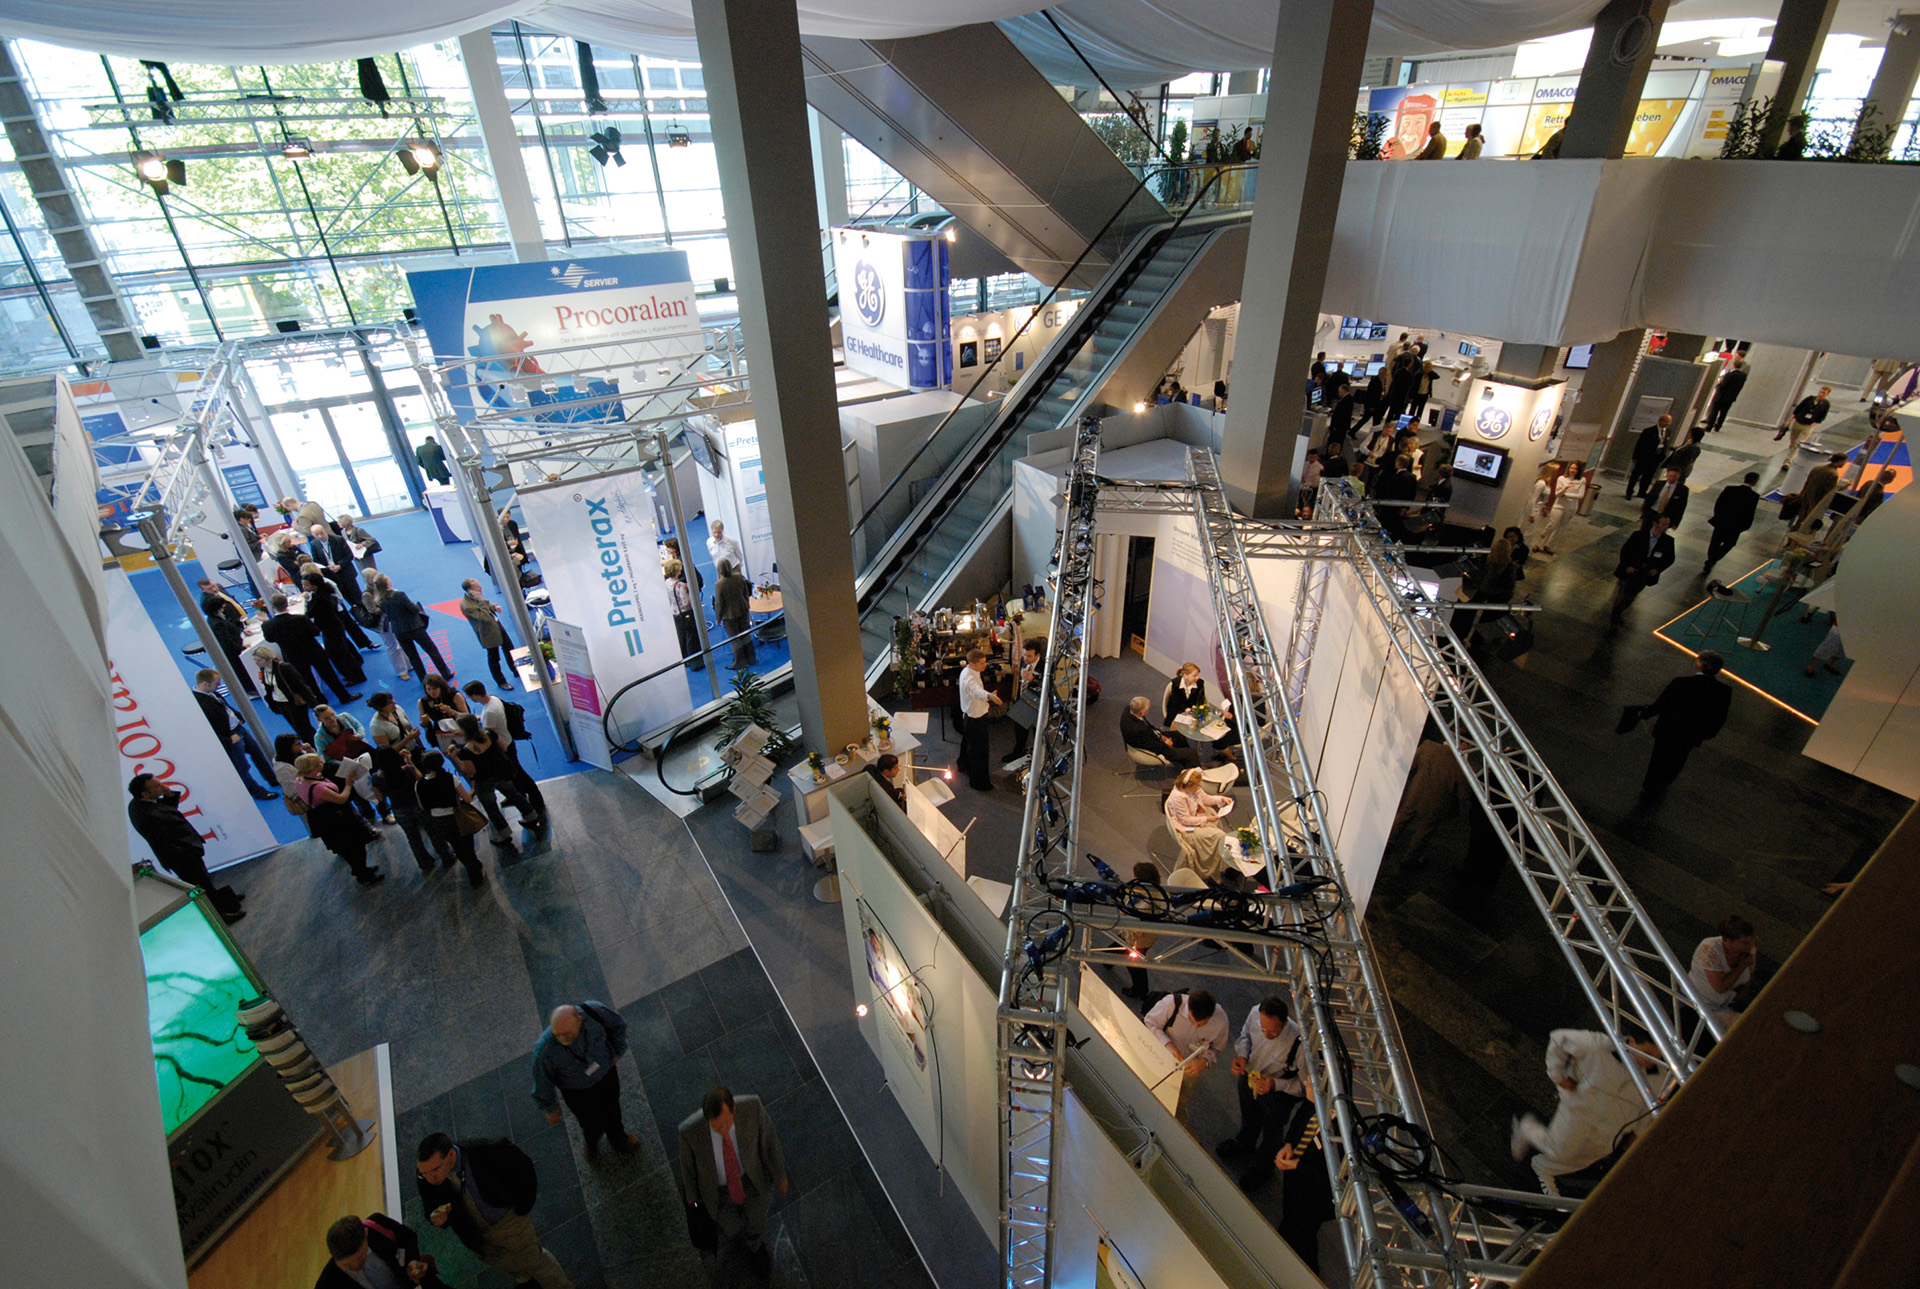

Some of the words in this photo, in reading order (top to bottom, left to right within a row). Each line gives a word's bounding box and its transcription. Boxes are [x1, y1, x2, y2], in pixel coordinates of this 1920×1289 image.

[583, 277, 618, 288] SERVIER
[846, 336, 857, 352] GE
[857, 339, 903, 368] Healthcare
